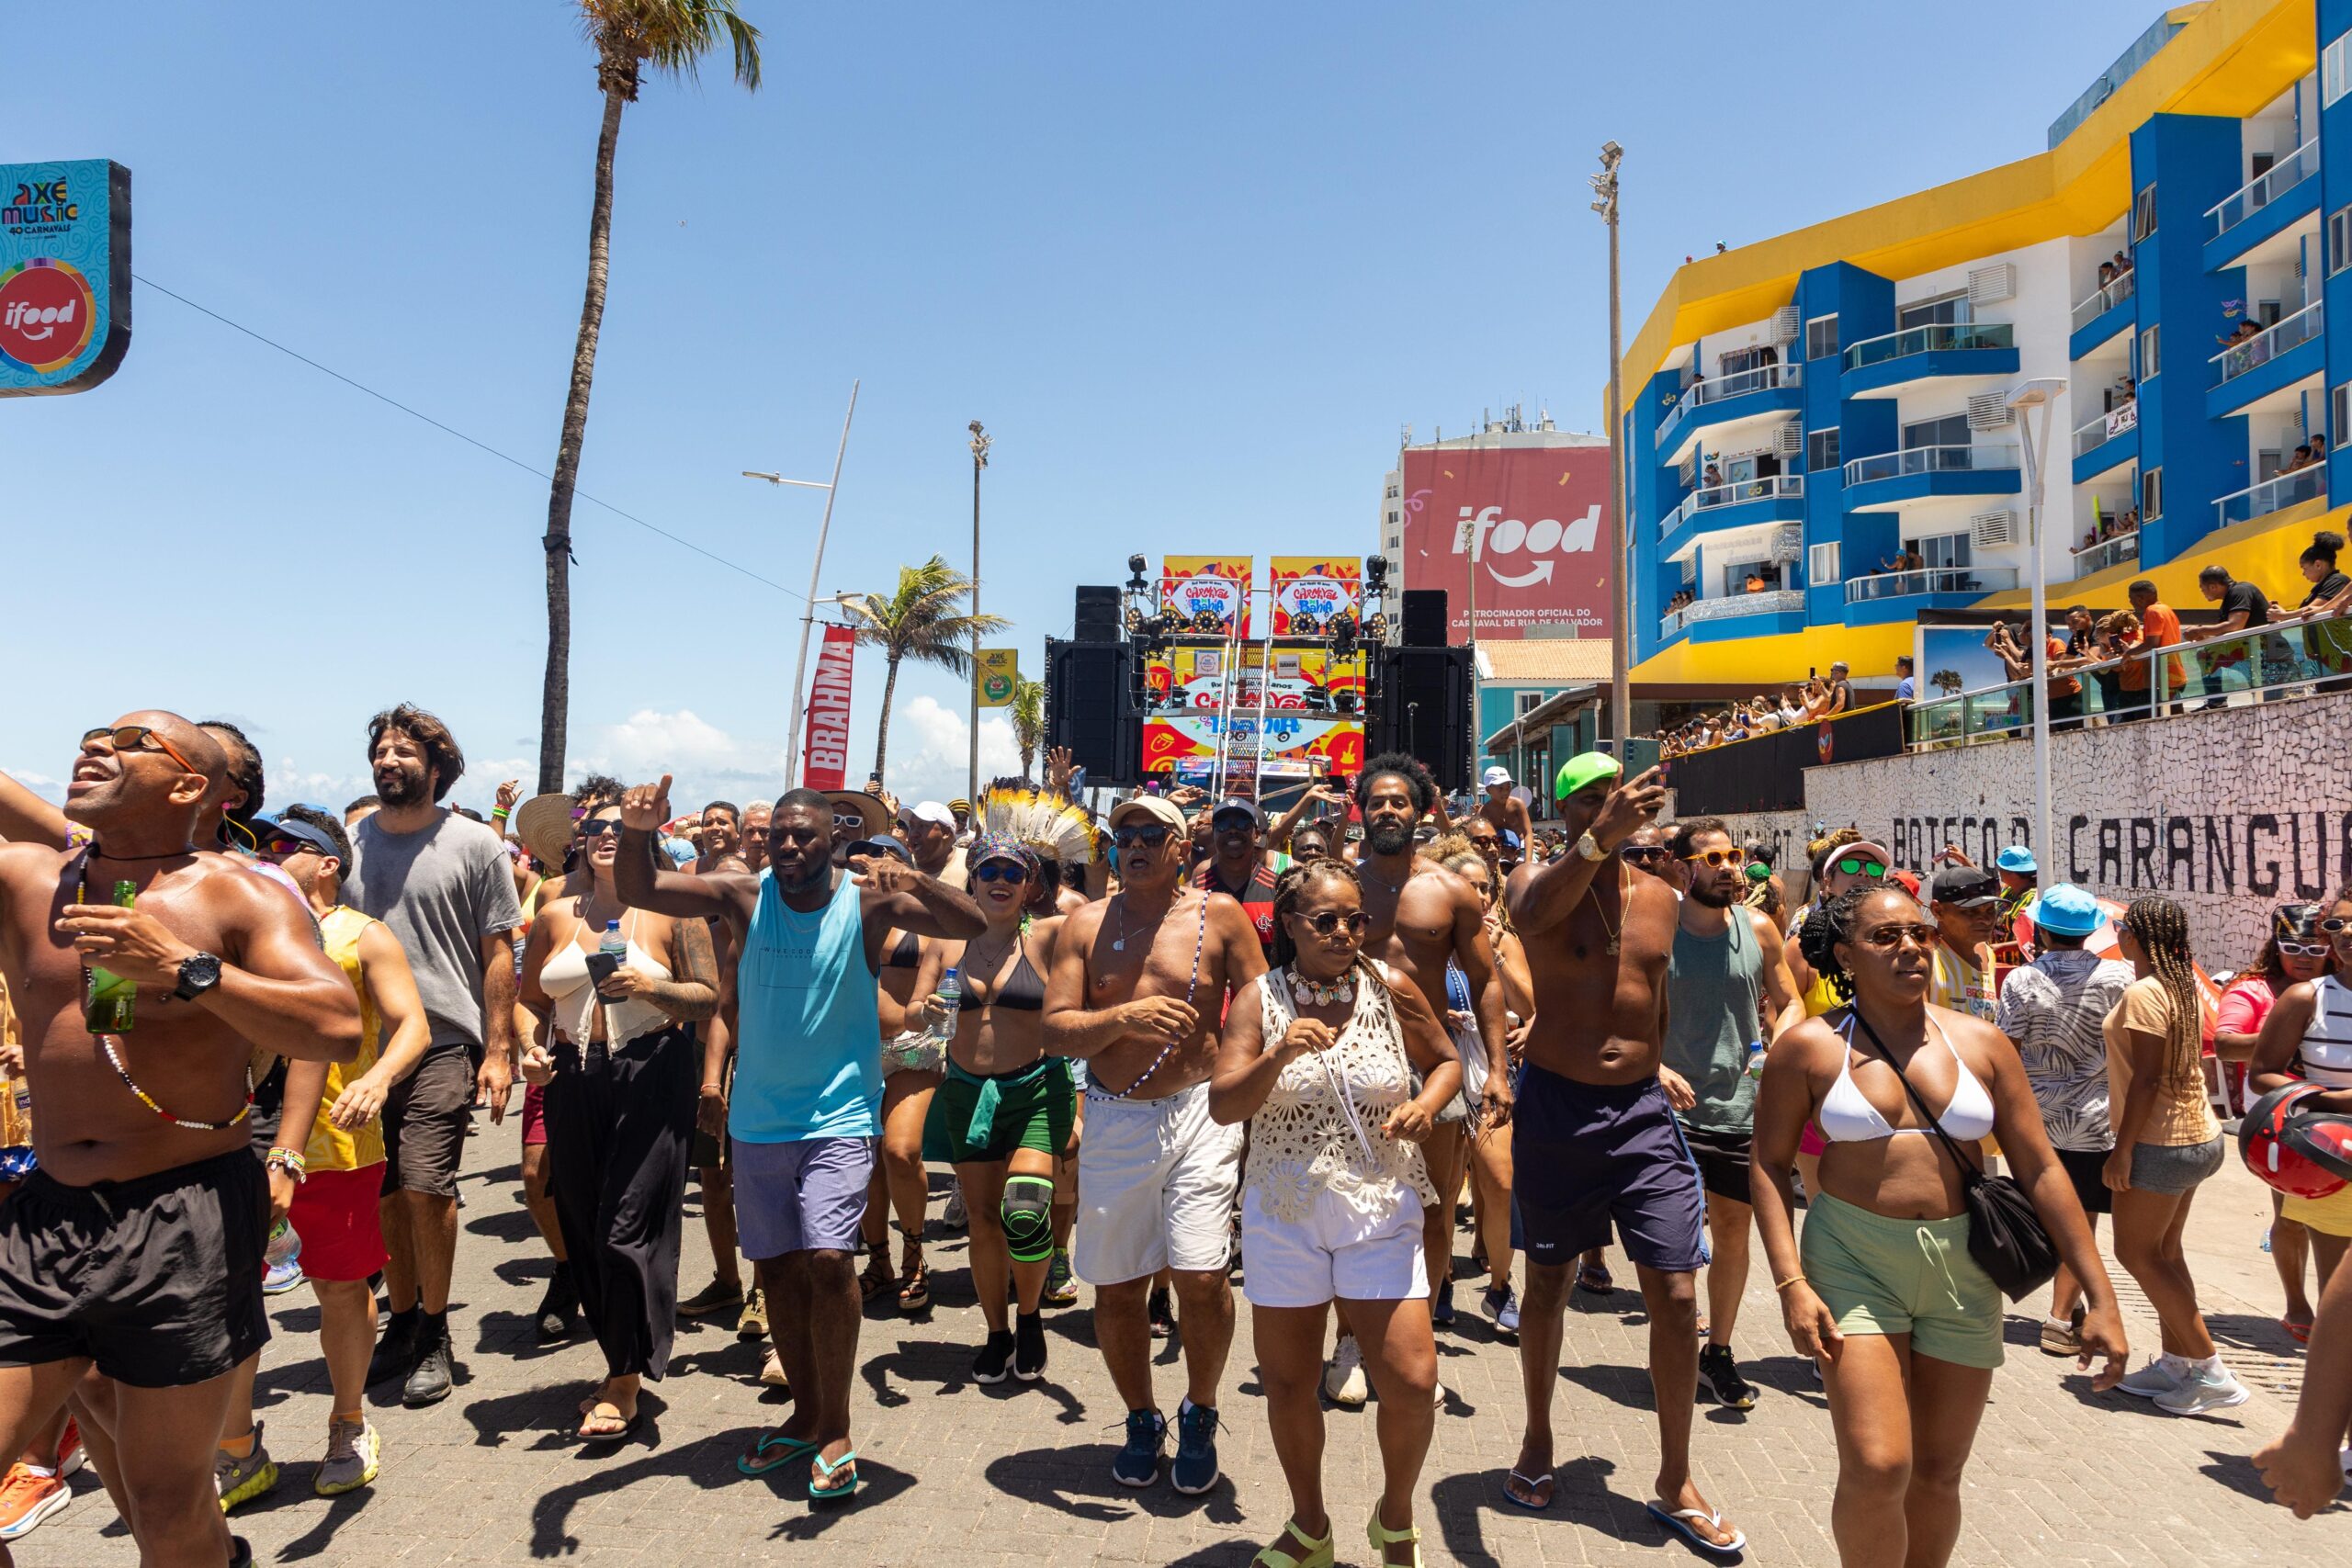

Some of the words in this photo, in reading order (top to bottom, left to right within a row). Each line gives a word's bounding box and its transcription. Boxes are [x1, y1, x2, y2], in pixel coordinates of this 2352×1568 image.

[9, 227, 23, 235] 40
[24, 224, 71, 234] CARNAVAIS
[5, 299, 76, 330] ifood
[1452, 504, 1601, 563] ifood
[1518, 618, 1537, 626] RUA
[1537, 608, 1574, 616] OFICIAL
[1577, 608, 1590, 616] DO
[810, 641, 854, 772] BRAHMA
